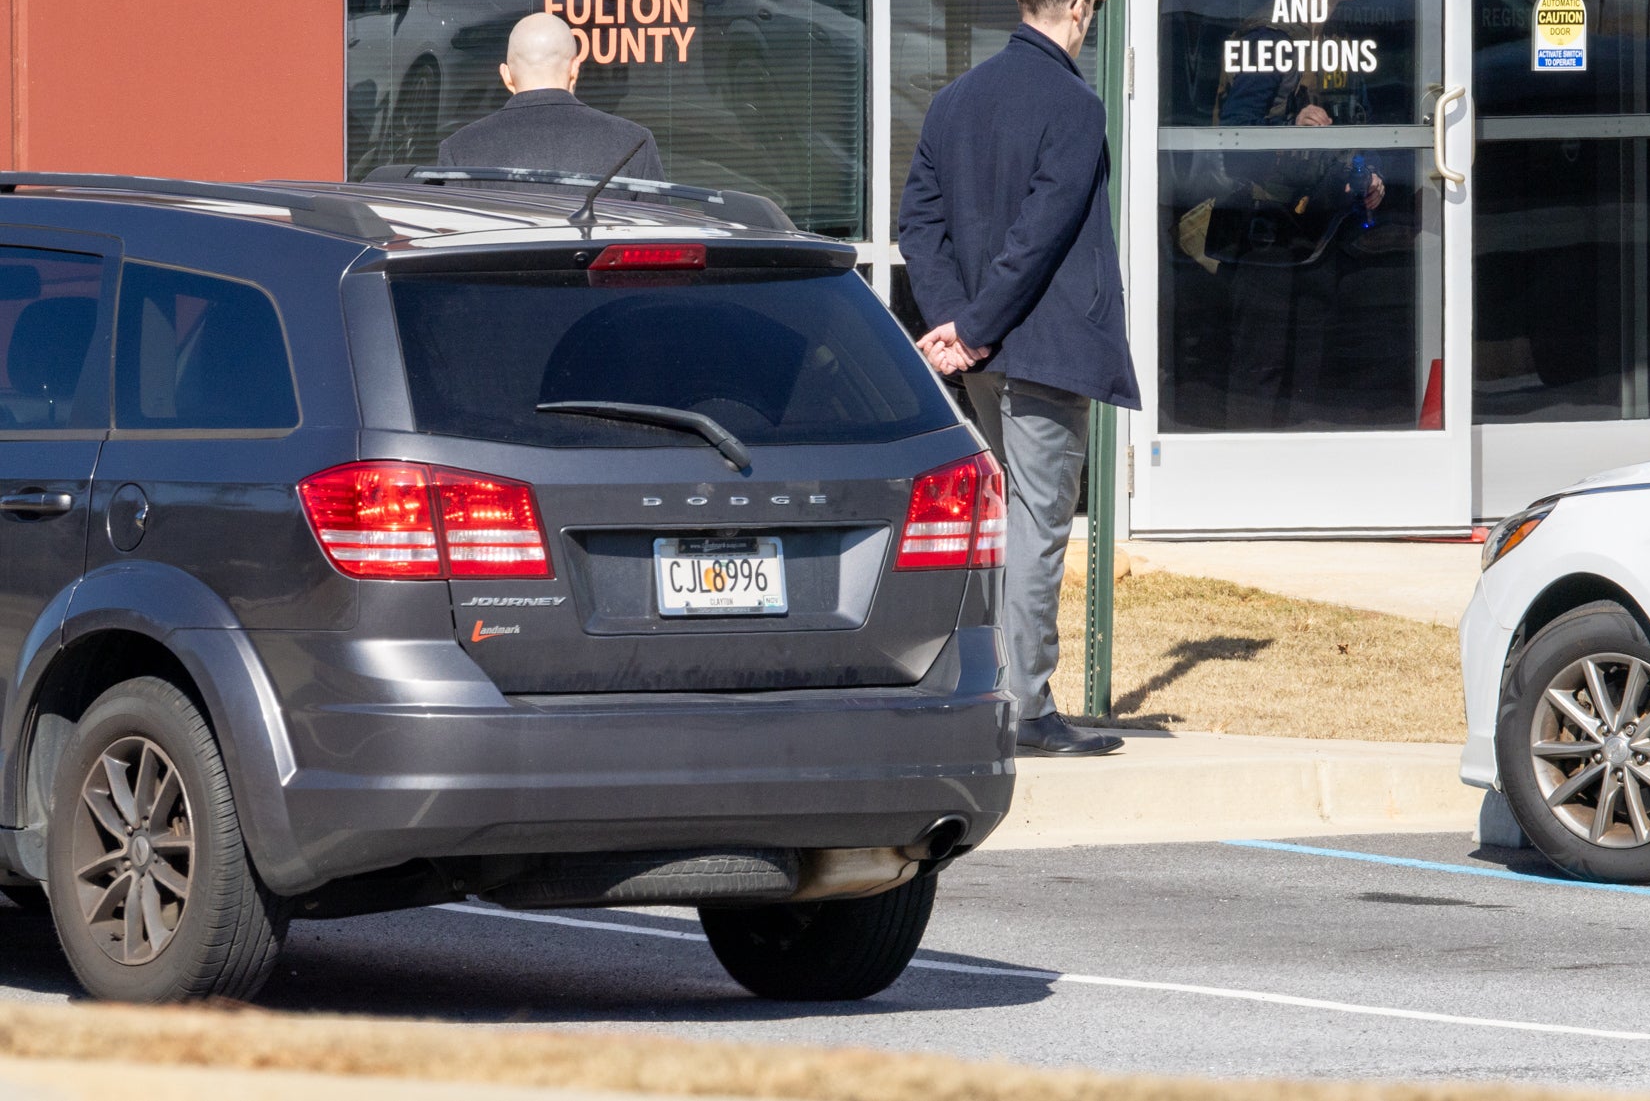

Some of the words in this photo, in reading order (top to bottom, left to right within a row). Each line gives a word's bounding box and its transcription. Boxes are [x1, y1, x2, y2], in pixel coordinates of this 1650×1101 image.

[1542, 0, 1580, 7] AUTOMATIC
[1538, 11, 1583, 24] CAUTION
[1550, 28, 1571, 36] DOOR
[570, 26, 696, 64] OUNTY
[1223, 40, 1378, 73] ELECTIONS
[1538, 50, 1562, 58] ACTIVATE
[1563, 50, 1583, 58] SWITCH
[1545, 58, 1552, 66] TO
[1552, 58, 1577, 66] OPERATE
[643, 494, 827, 506] DODGE
[670, 558, 768, 593] CJL8996
[460, 596, 566, 607] JOURNEY
[709, 597, 734, 606] CLAYTON
[471, 620, 520, 642] Landmark
